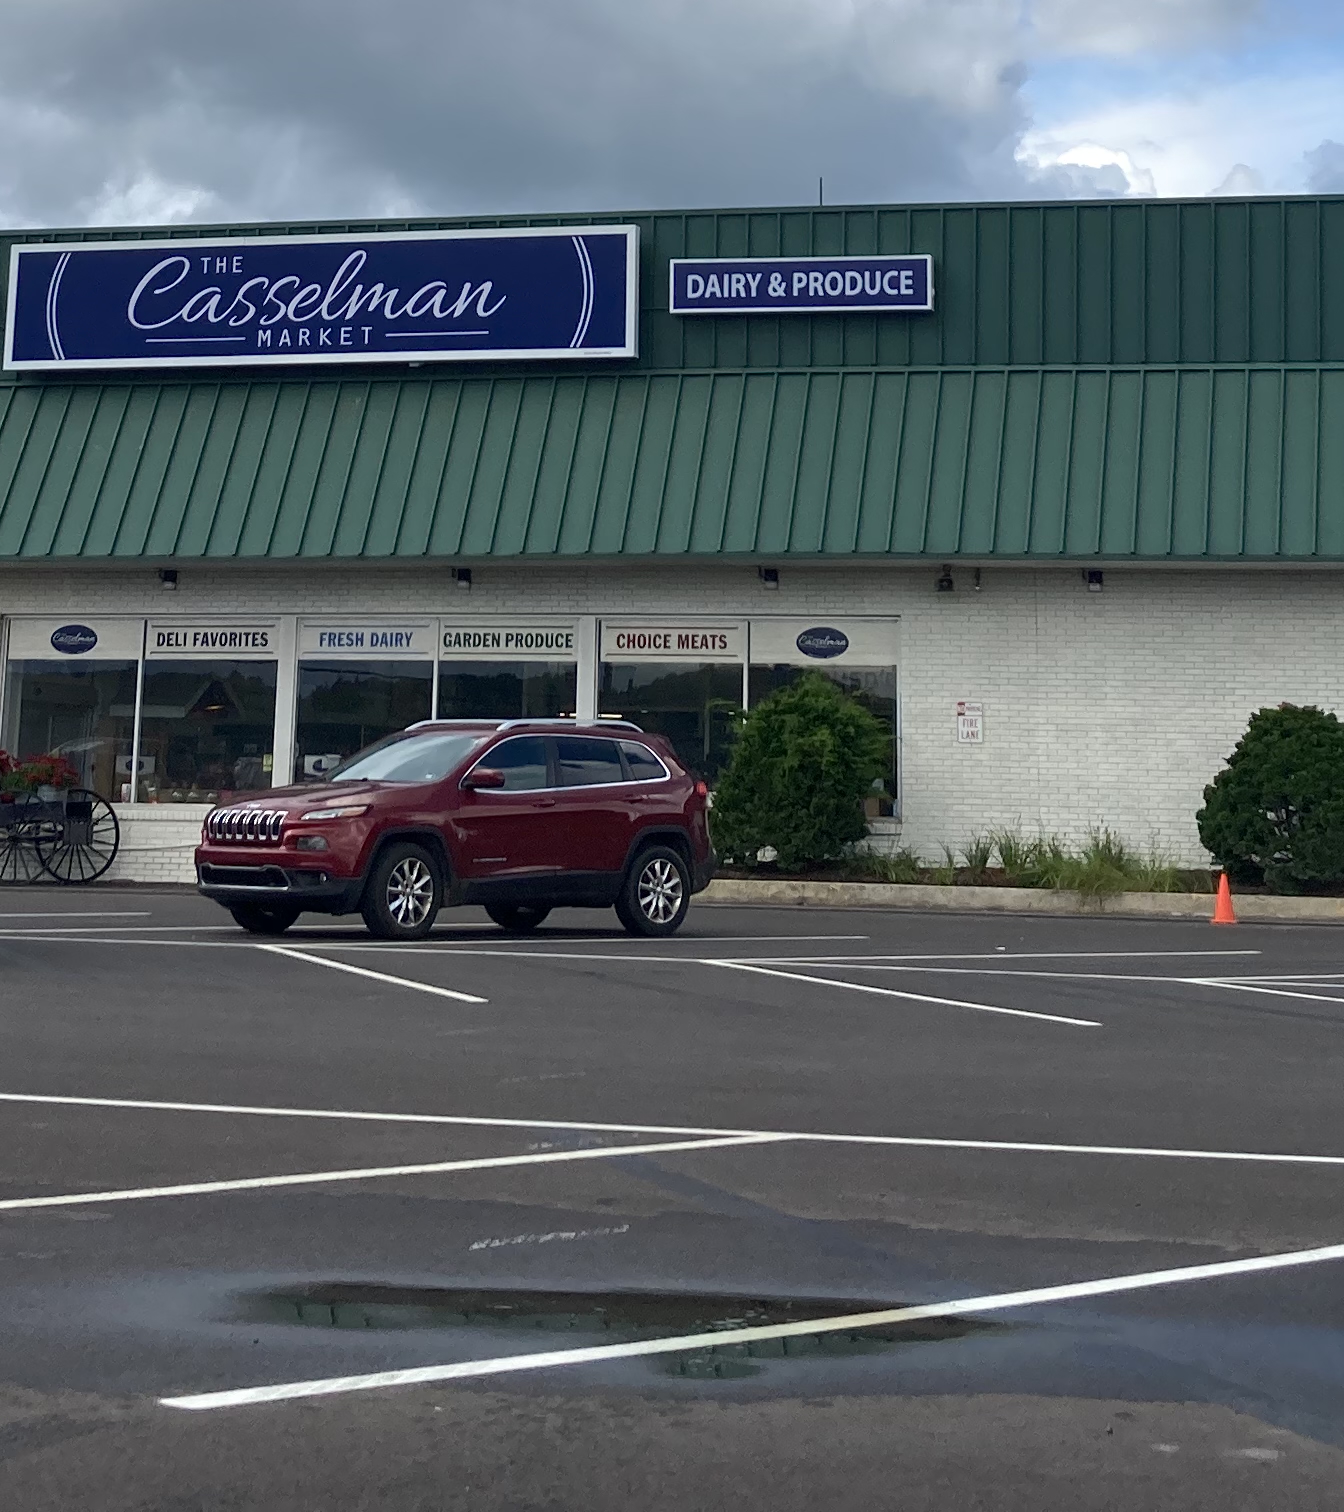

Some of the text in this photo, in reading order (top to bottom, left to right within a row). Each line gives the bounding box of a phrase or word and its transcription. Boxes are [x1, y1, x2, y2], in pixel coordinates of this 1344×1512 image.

[201, 256, 244, 275] THE
[128, 249, 507, 330] Casselman
[687, 270, 914, 299] DAIRY & PRODUCE
[257, 326, 373, 348] MARKET
[157, 631, 269, 647] DELI FAVORITES
[319, 631, 414, 648] FRESH DAIRY
[443, 632, 574, 649] GARDEN PRODUCE
[616, 633, 728, 650] CHOICE MEATS
[962, 718, 978, 729] FIRE
